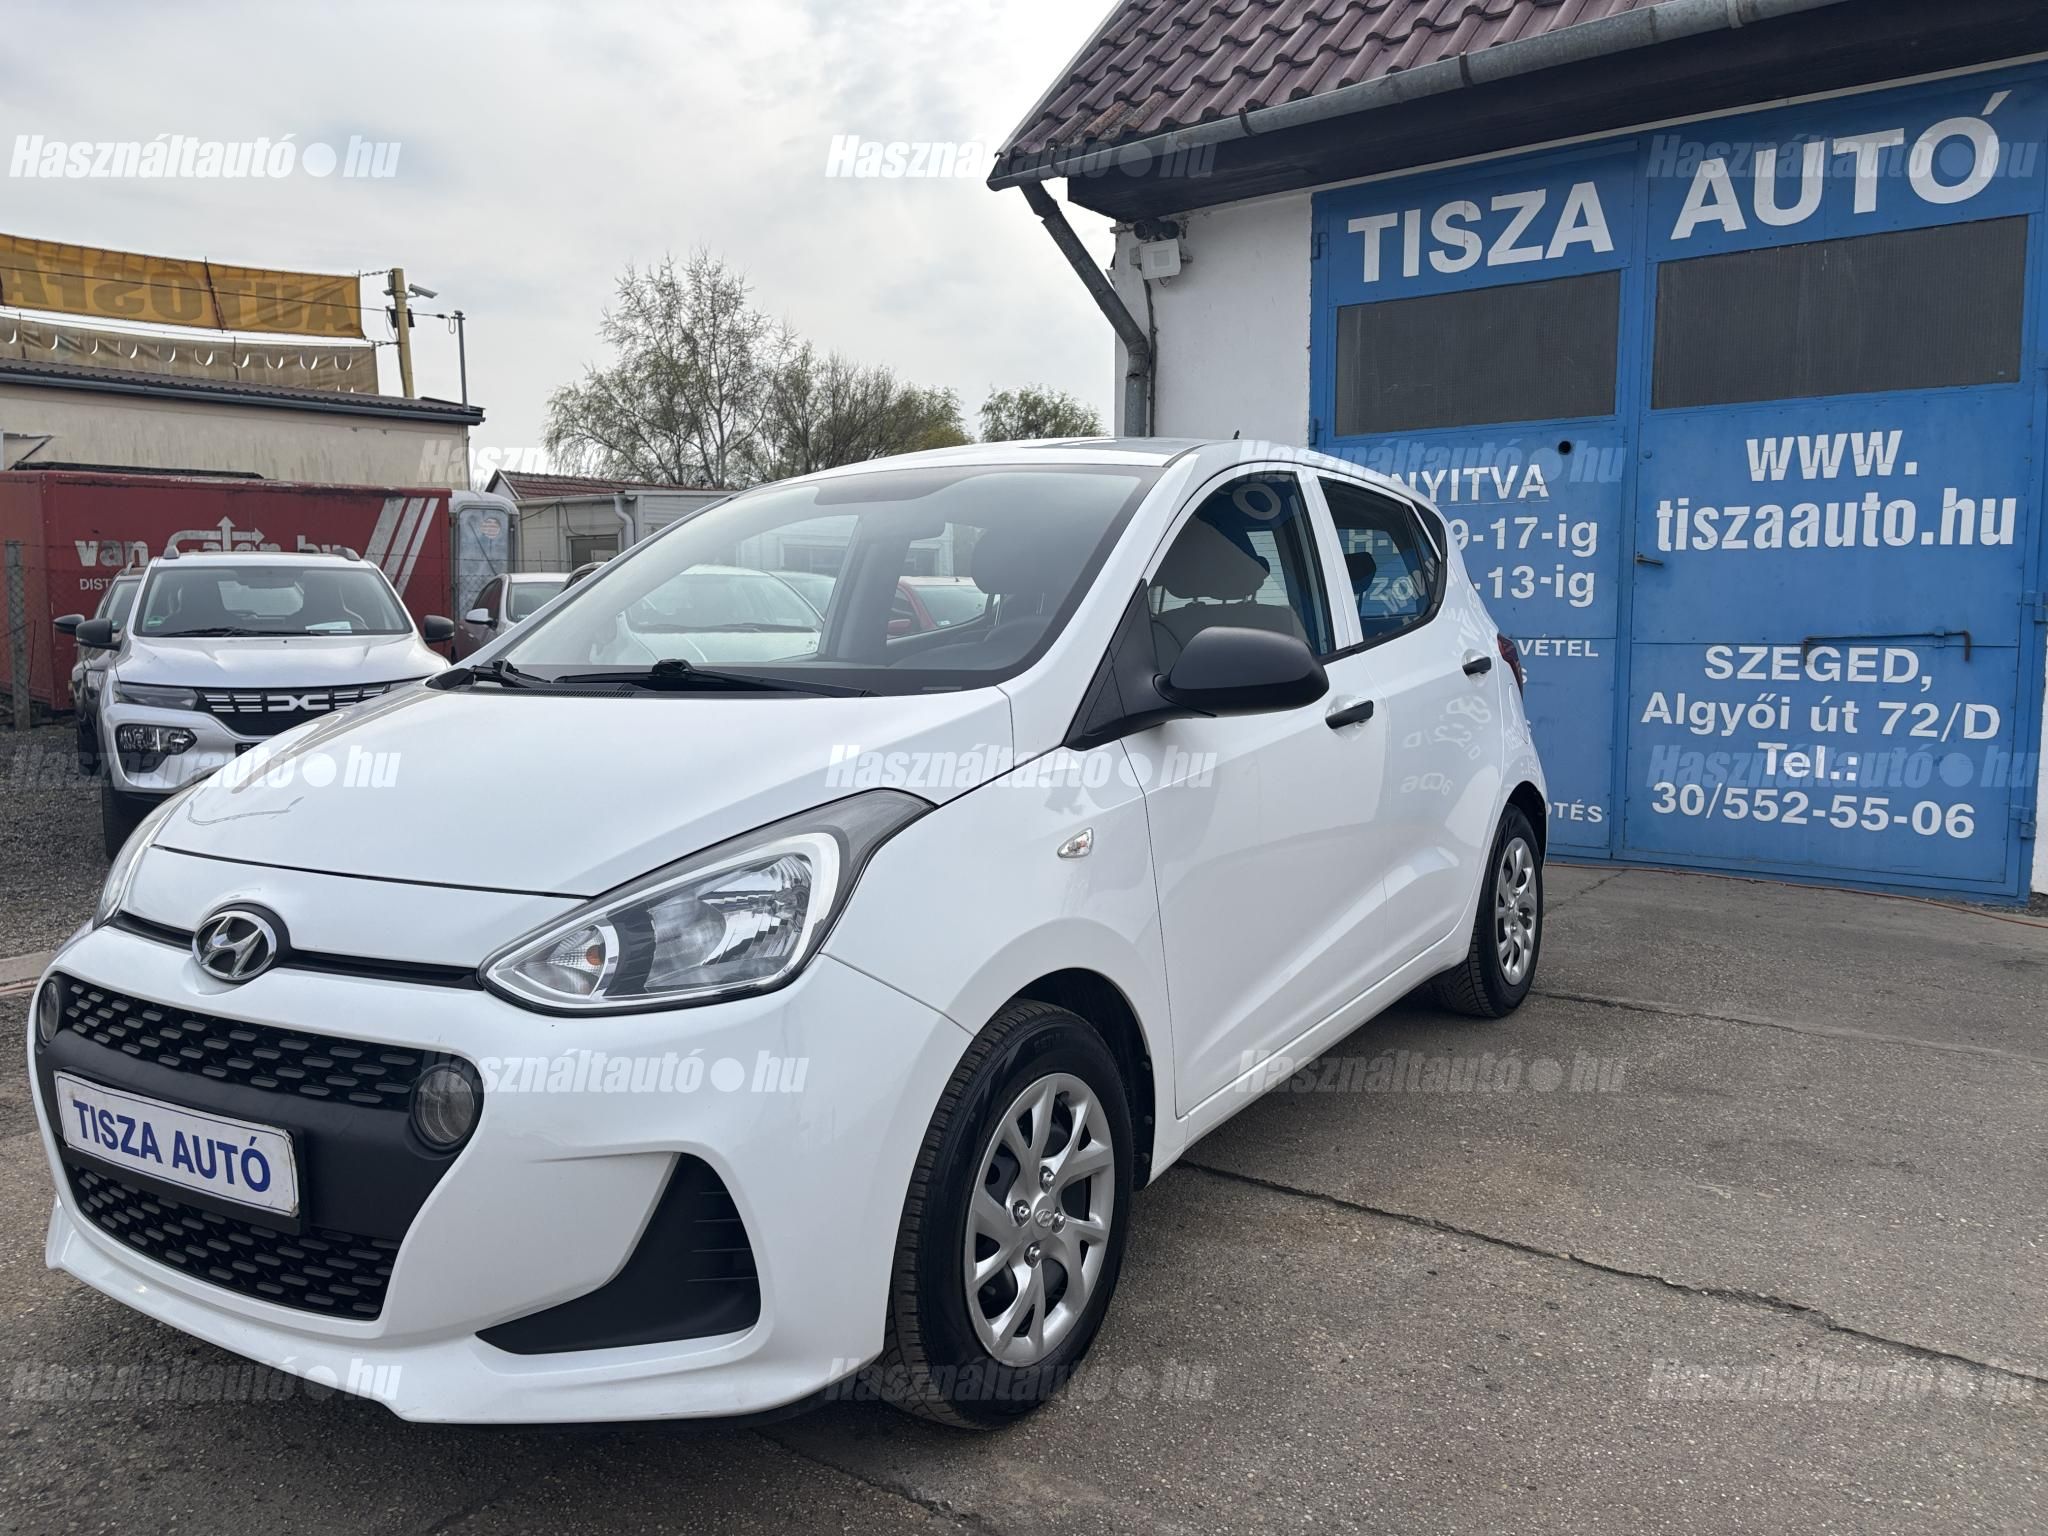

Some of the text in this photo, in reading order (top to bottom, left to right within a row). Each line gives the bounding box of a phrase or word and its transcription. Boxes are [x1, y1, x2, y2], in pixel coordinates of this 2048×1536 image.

[1348, 89, 2012, 283] TISZA AUTÓ
[1746, 429, 1918, 482] www.
[1656, 487, 2017, 551] tiszaauto.hu
[74, 540, 149, 567] van
[1704, 645, 1932, 691] SZEGED,
[1641, 692, 2000, 741] Algyői út 72/D
[1758, 742, 1858, 782] Tel.:
[1652, 782, 1976, 839] 30/552-55-06
[72, 1099, 272, 1193] TISZA AUTÓ
